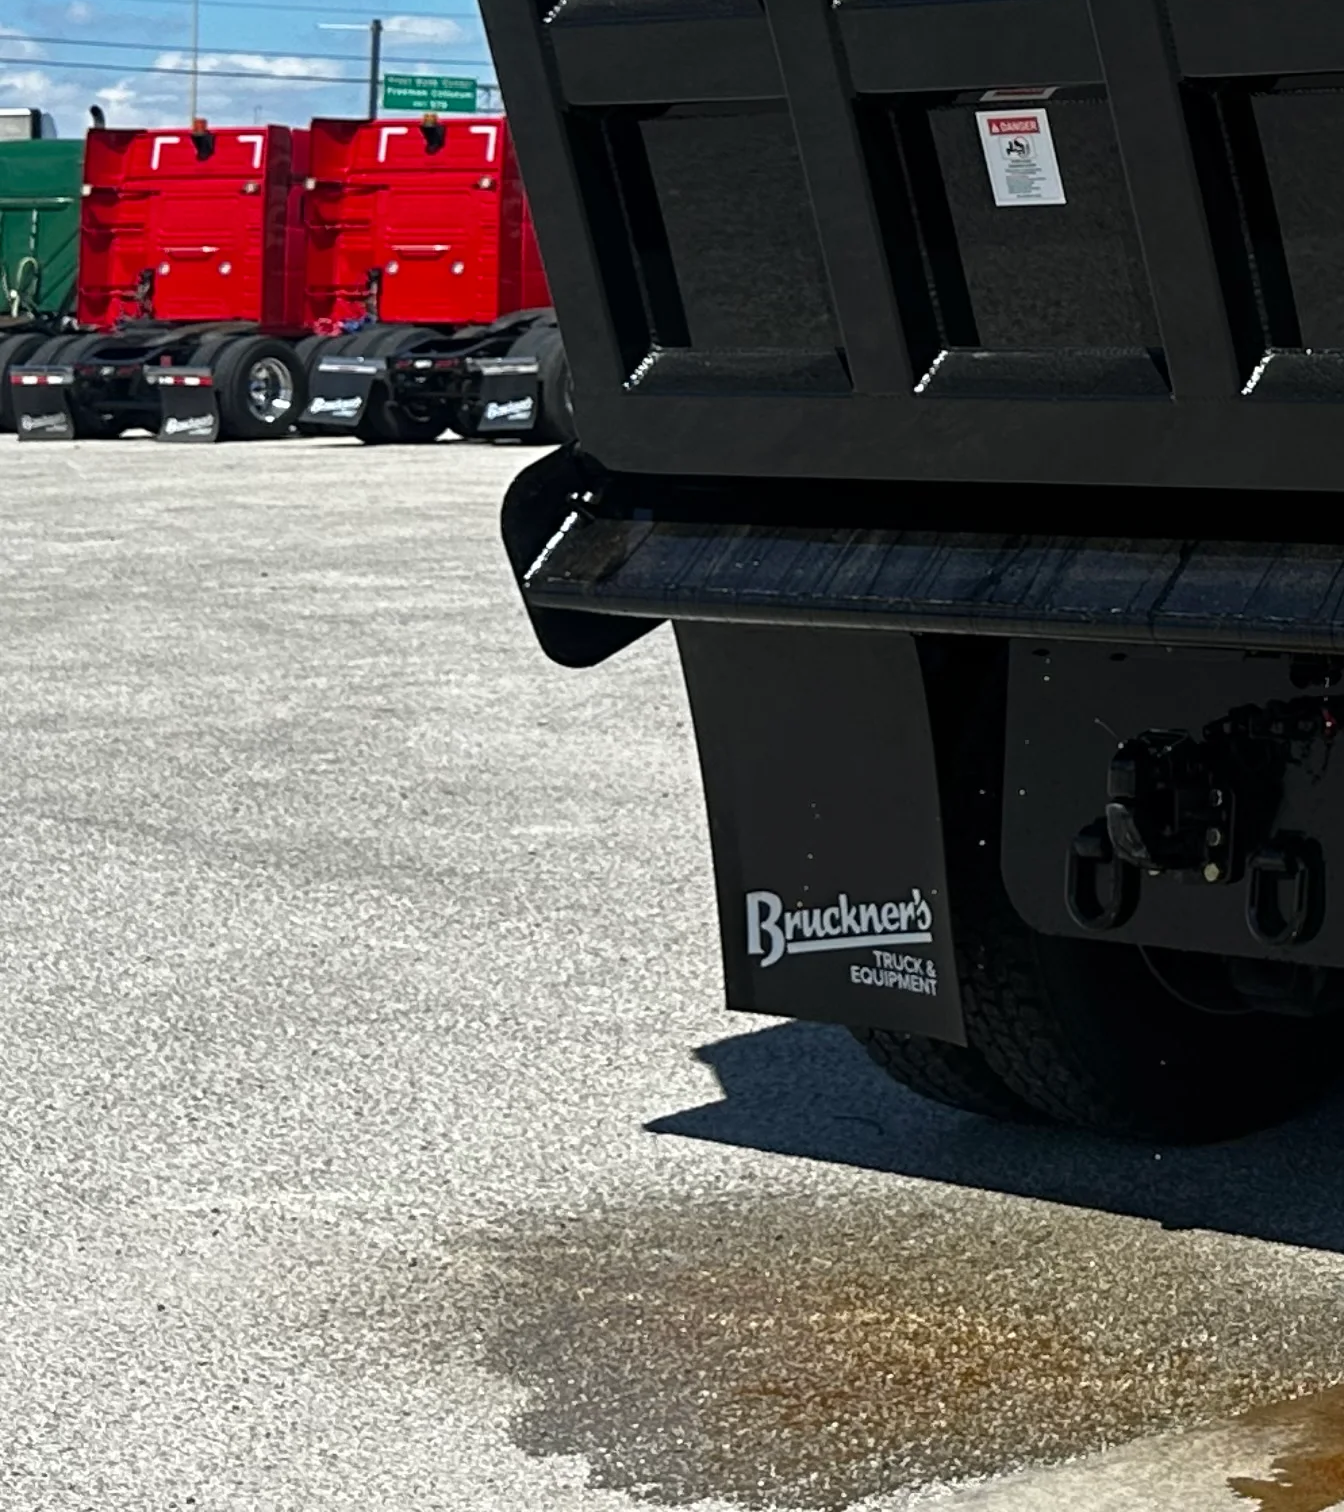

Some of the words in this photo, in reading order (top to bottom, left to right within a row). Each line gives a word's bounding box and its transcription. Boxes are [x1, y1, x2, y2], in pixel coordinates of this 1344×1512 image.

[746, 888, 933, 968] Bruckner's
[850, 964, 937, 996] EQUIPMENT
[872, 950, 923, 975] TRUCK
[925, 959, 937, 978] &
